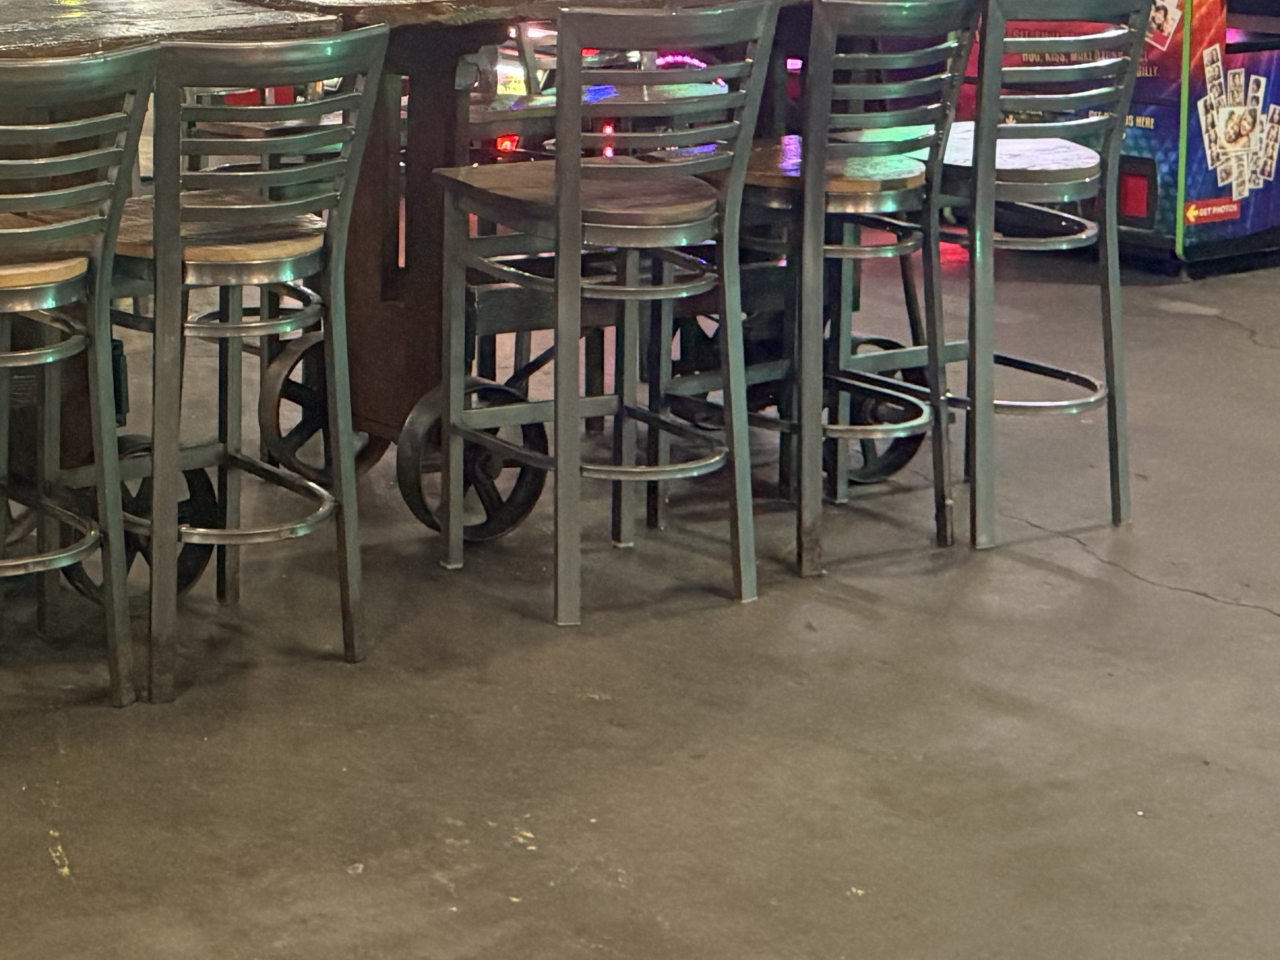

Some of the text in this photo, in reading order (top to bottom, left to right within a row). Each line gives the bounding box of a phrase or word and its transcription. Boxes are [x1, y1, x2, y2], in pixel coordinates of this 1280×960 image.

[1135, 115, 1155, 129] HERE
[1199, 204, 1238, 217] GET PHOTOS
